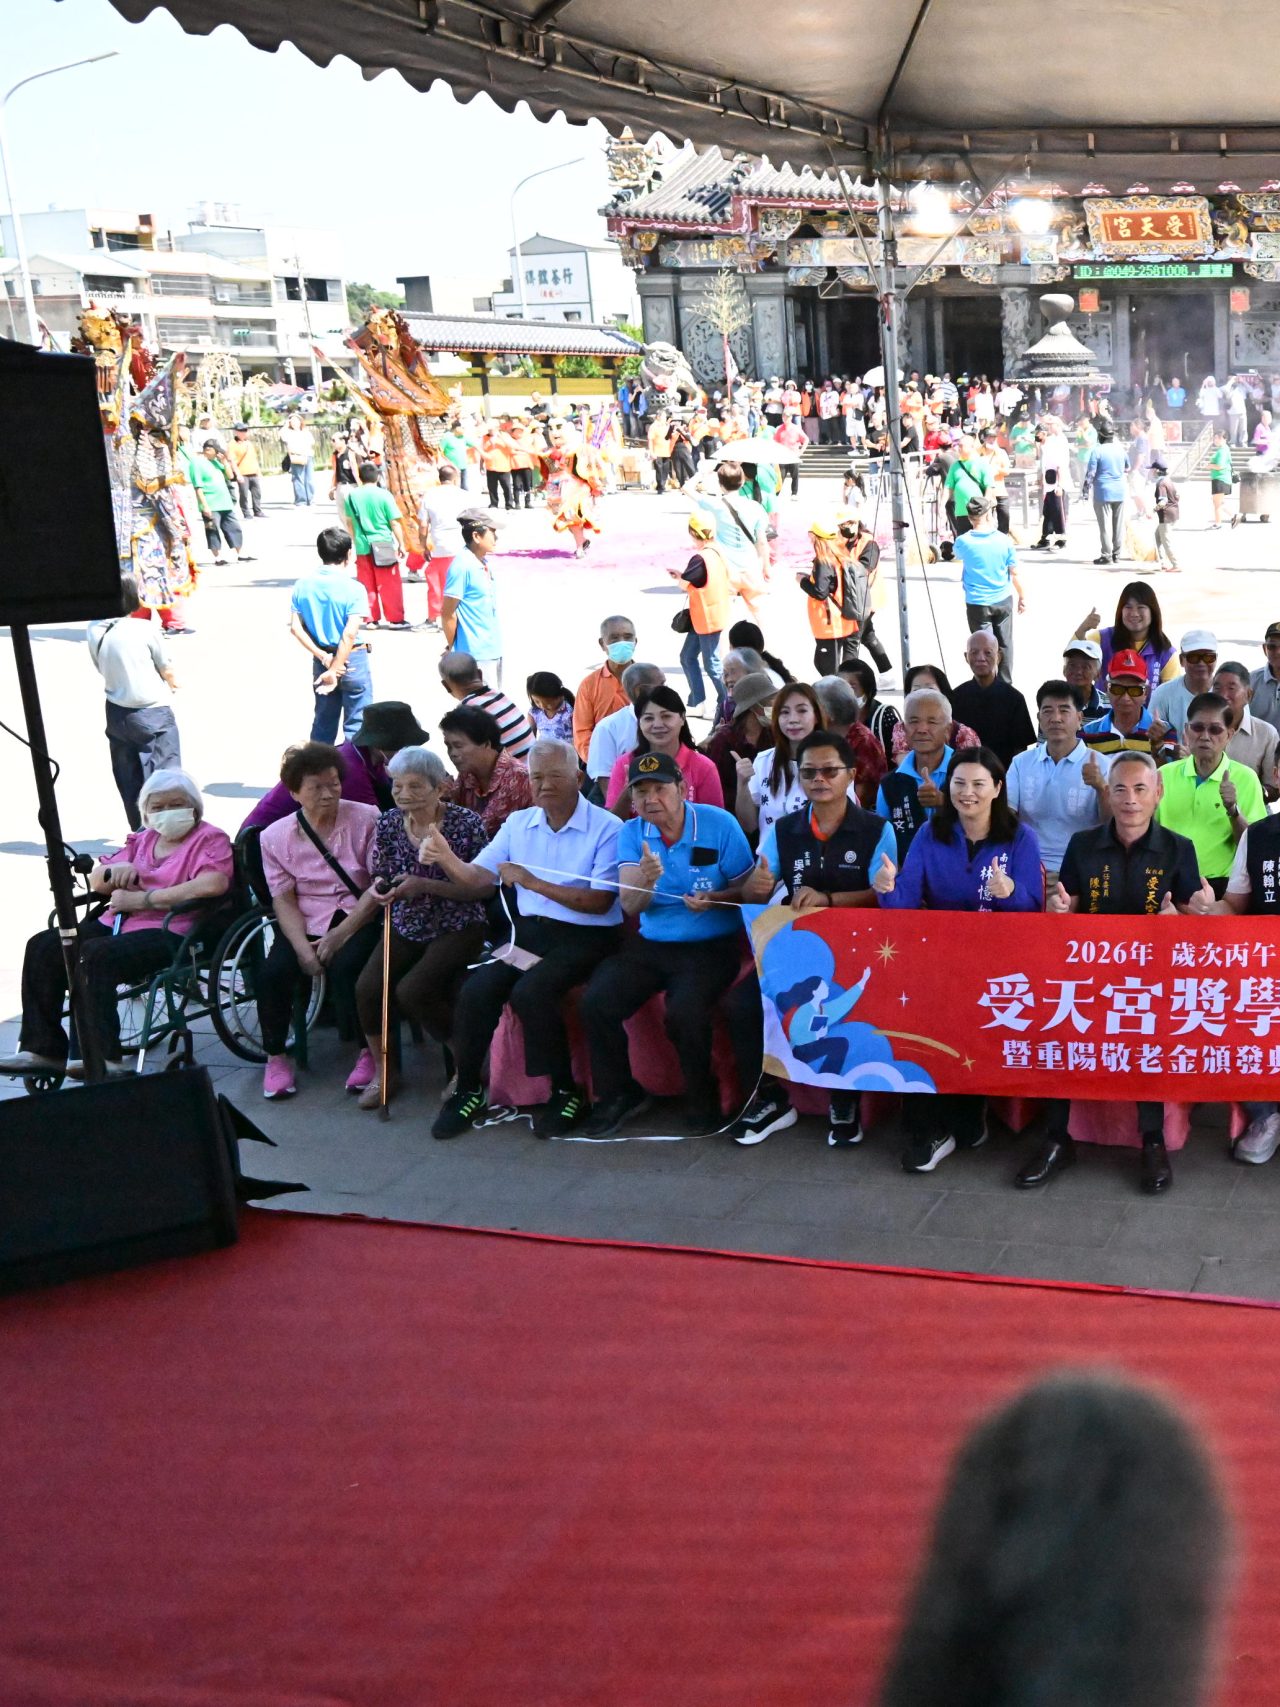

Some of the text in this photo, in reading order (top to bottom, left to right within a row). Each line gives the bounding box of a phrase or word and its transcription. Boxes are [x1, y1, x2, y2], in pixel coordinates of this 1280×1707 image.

[893, 807, 905, 832] 謝文
[1263, 859, 1276, 903] 陳翰立
[1065, 940, 1277, 968] 2026年 歲次丙午
